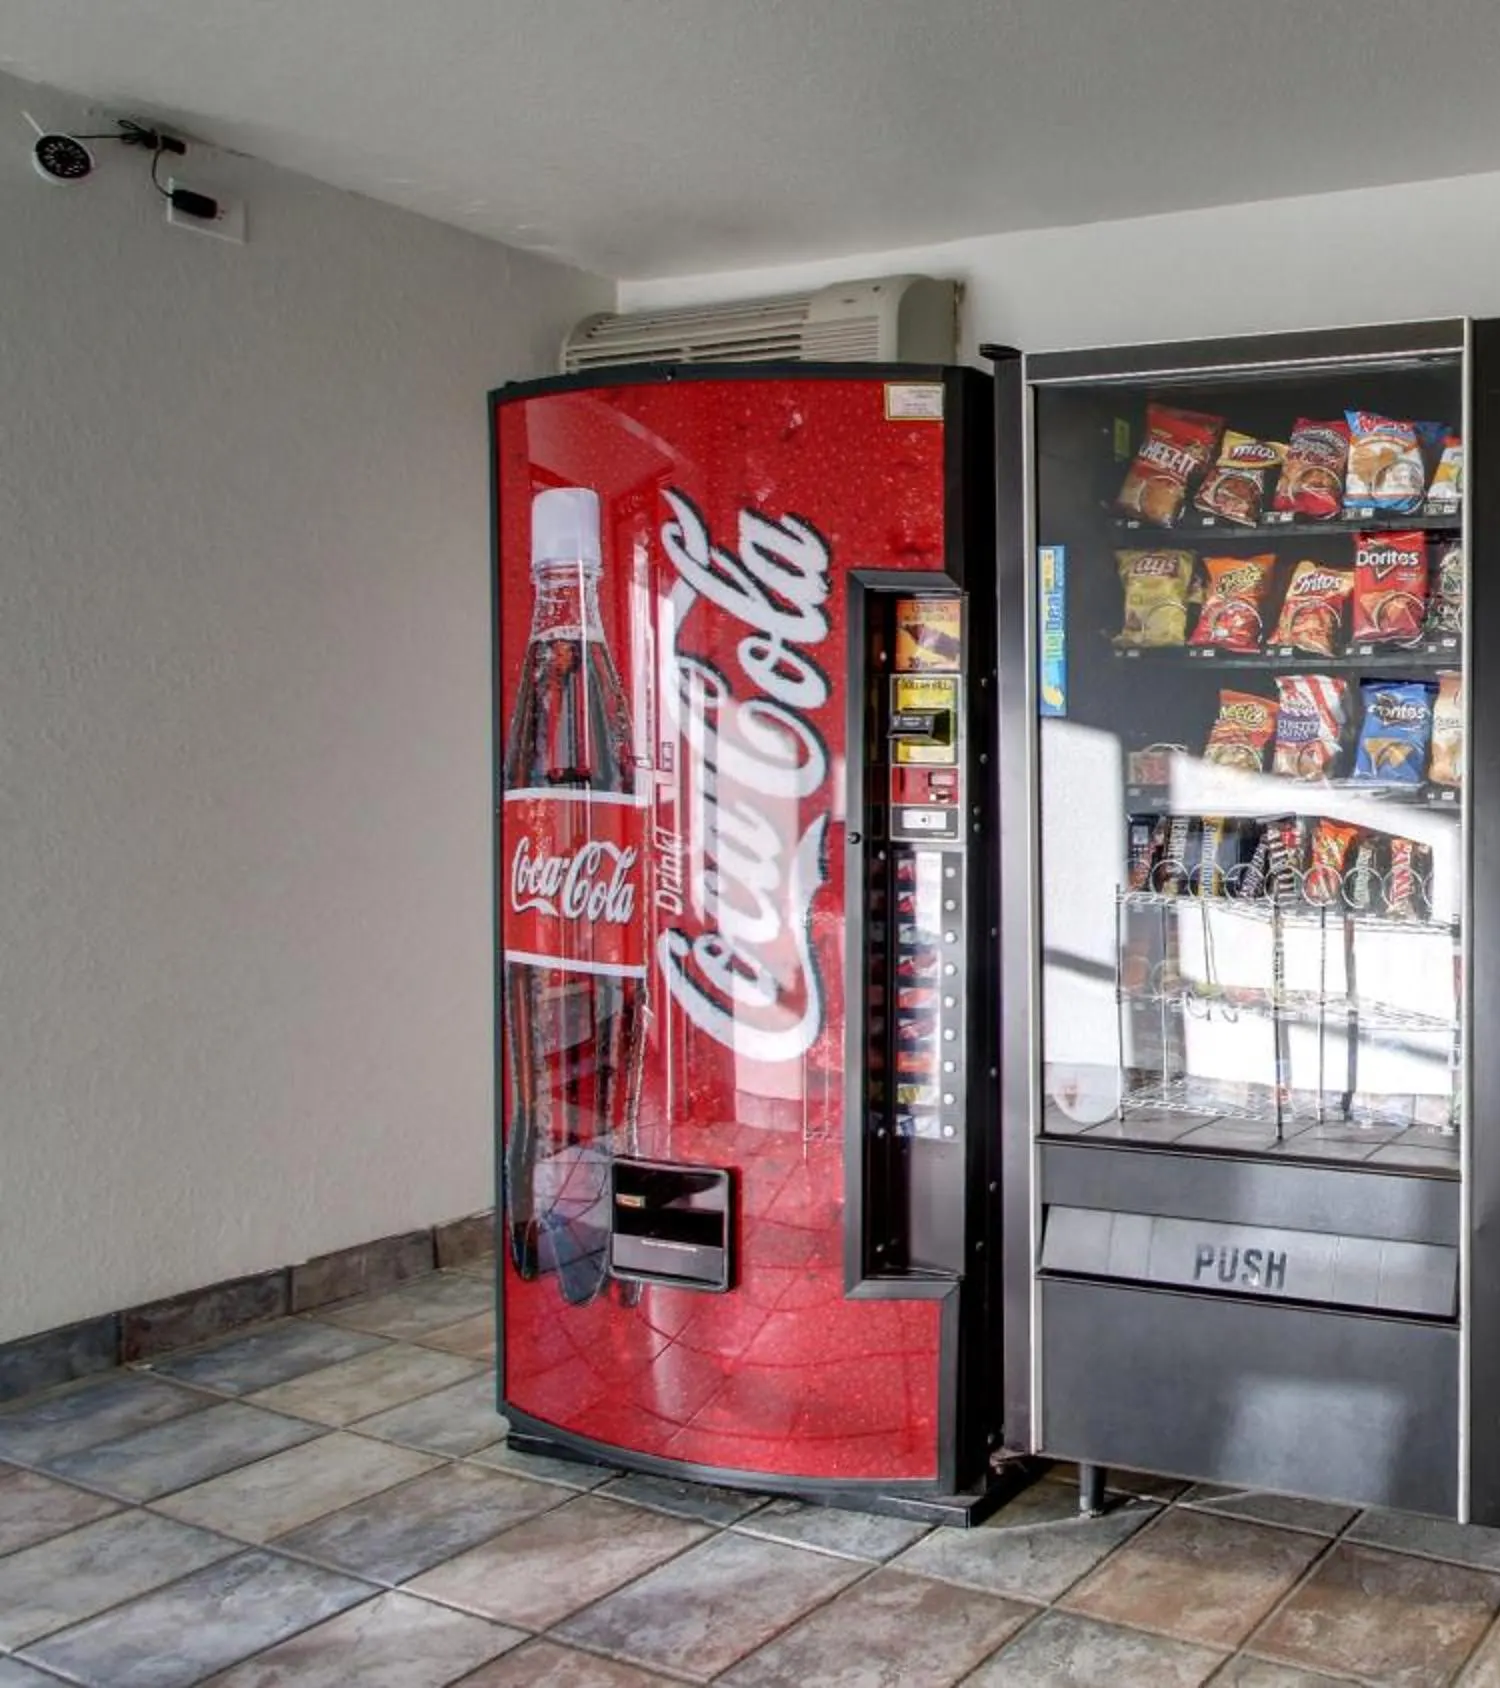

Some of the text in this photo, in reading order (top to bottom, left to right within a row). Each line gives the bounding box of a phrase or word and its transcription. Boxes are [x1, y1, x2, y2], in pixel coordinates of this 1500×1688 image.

[1355, 550, 1419, 567] Doritos
[1294, 573, 1341, 594] Fritos
[657, 487, 832, 1062] Coca-Cola
[511, 836, 638, 923] Coca-Cola
[1193, 1244, 1287, 1290] PUSH
